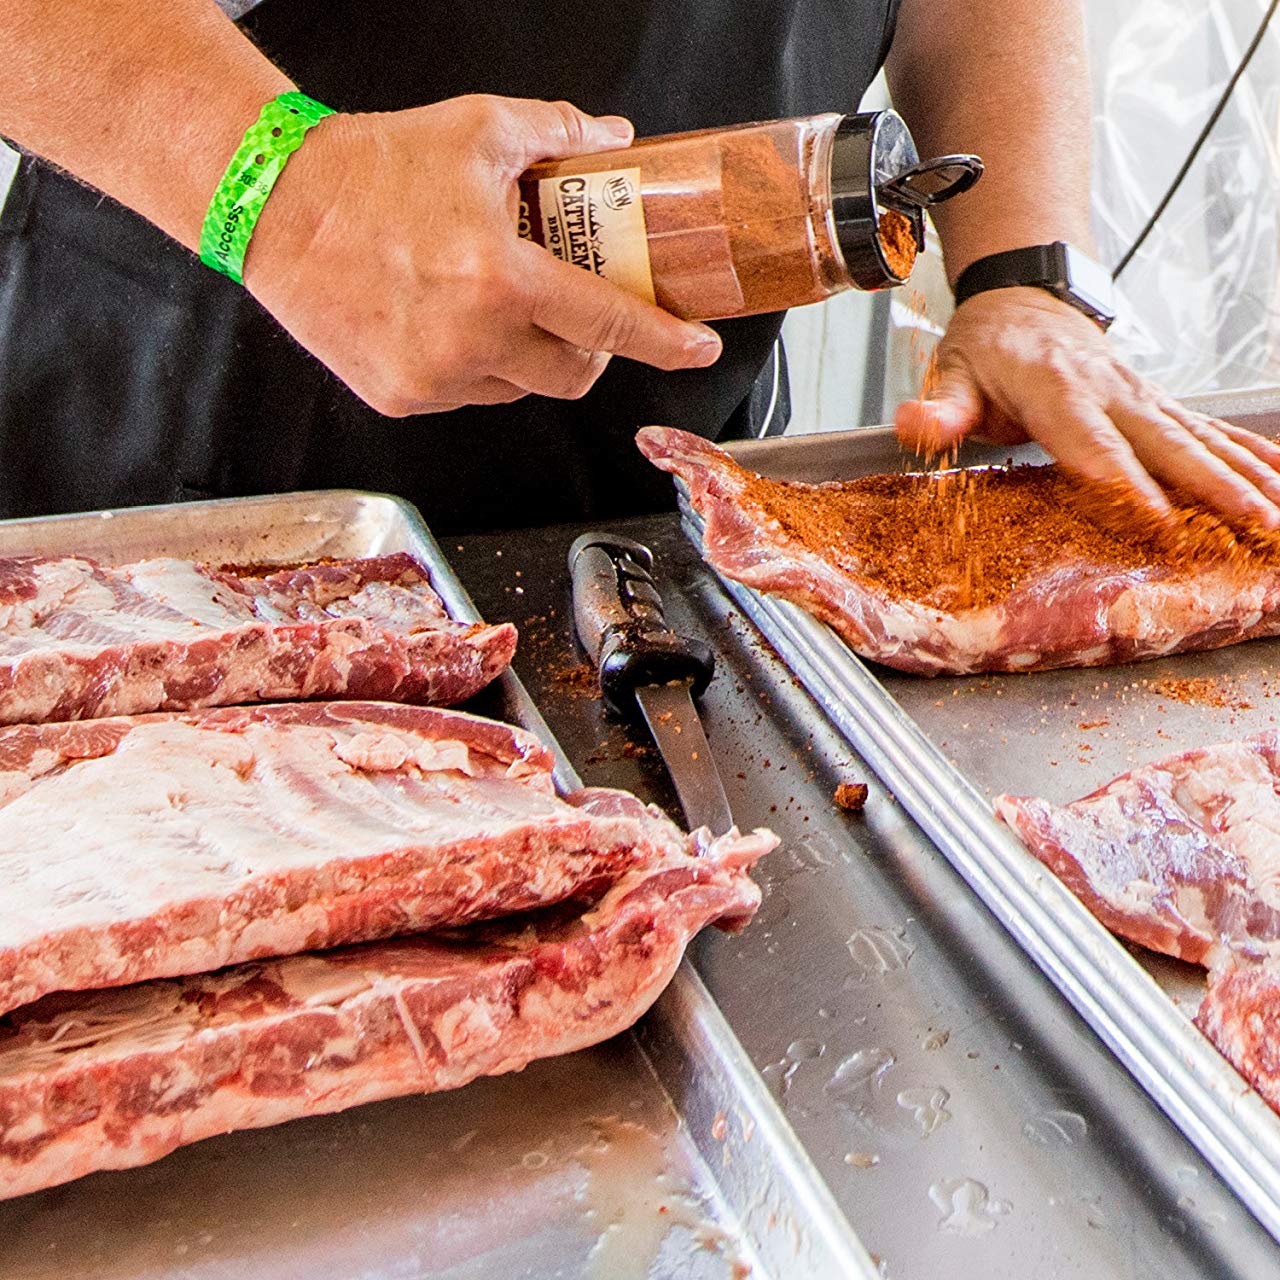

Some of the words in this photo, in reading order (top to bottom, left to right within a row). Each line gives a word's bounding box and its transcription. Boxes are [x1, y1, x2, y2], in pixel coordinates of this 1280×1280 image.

[608, 176, 633, 208] NEW
[215, 203, 244, 262] Access
[518, 200, 532, 241] CO
[547, 215, 561, 245] BBQ
